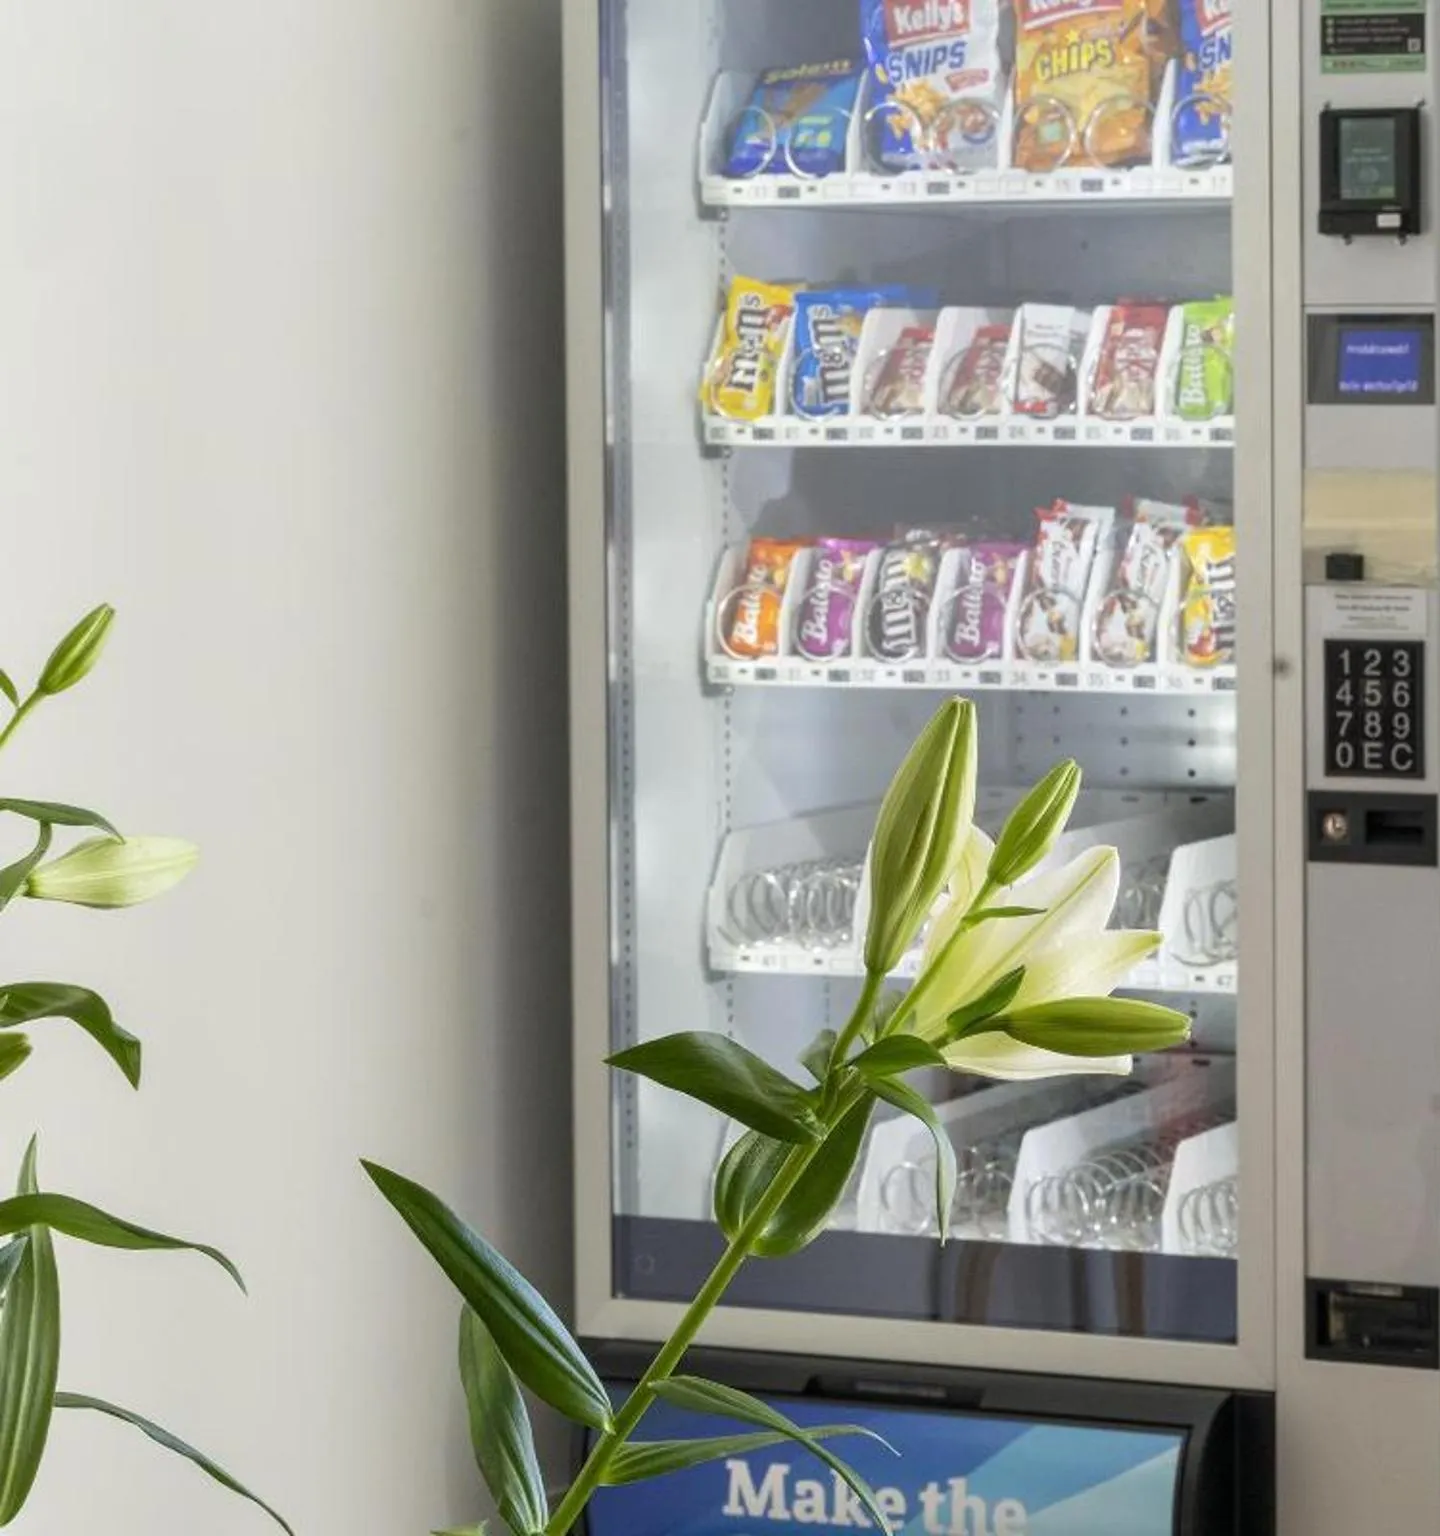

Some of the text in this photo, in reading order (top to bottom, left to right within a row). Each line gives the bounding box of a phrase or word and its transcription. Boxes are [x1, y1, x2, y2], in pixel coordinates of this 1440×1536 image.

[887, 40, 968, 83] SNIPS
[1035, 36, 1113, 82] CHIPS
[1339, 648, 1411, 677] 1 2 3
[1336, 680, 1410, 707] 4 5 6
[1336, 711, 1410, 739] 7 8 9
[1363, 742, 1383, 769] E
[1391, 742, 1413, 771] C
[722, 1459, 1028, 1536] Make the
